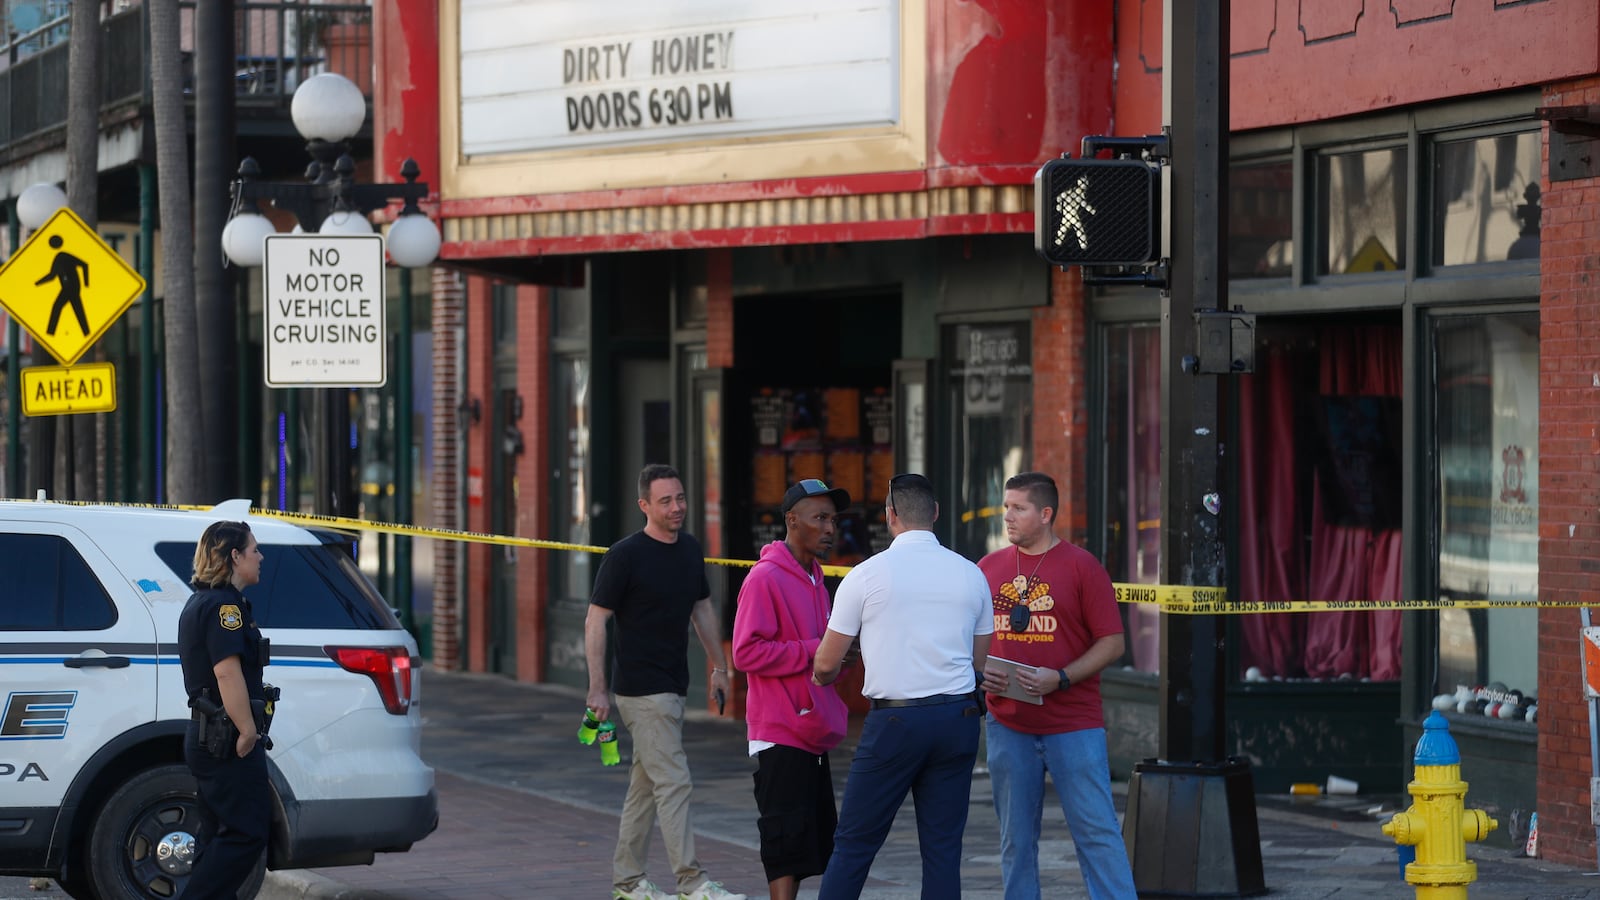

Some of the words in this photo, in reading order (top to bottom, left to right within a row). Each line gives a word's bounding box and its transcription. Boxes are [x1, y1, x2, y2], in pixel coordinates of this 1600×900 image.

[563, 42, 632, 84] DIRTY
[652, 31, 734, 76] HONEY
[566, 90, 642, 132] DOORS
[697, 81, 733, 120] PM
[309, 248, 340, 267] NO
[286, 273, 363, 292] MOTOR
[278, 298, 371, 318] VEHICLE
[273, 324, 377, 344] CRUISING
[35, 377, 103, 402] AHEAD
[1125, 588, 1157, 602] CRIME
[993, 614, 1012, 632] BE
[1006, 632, 1054, 644] everyone
